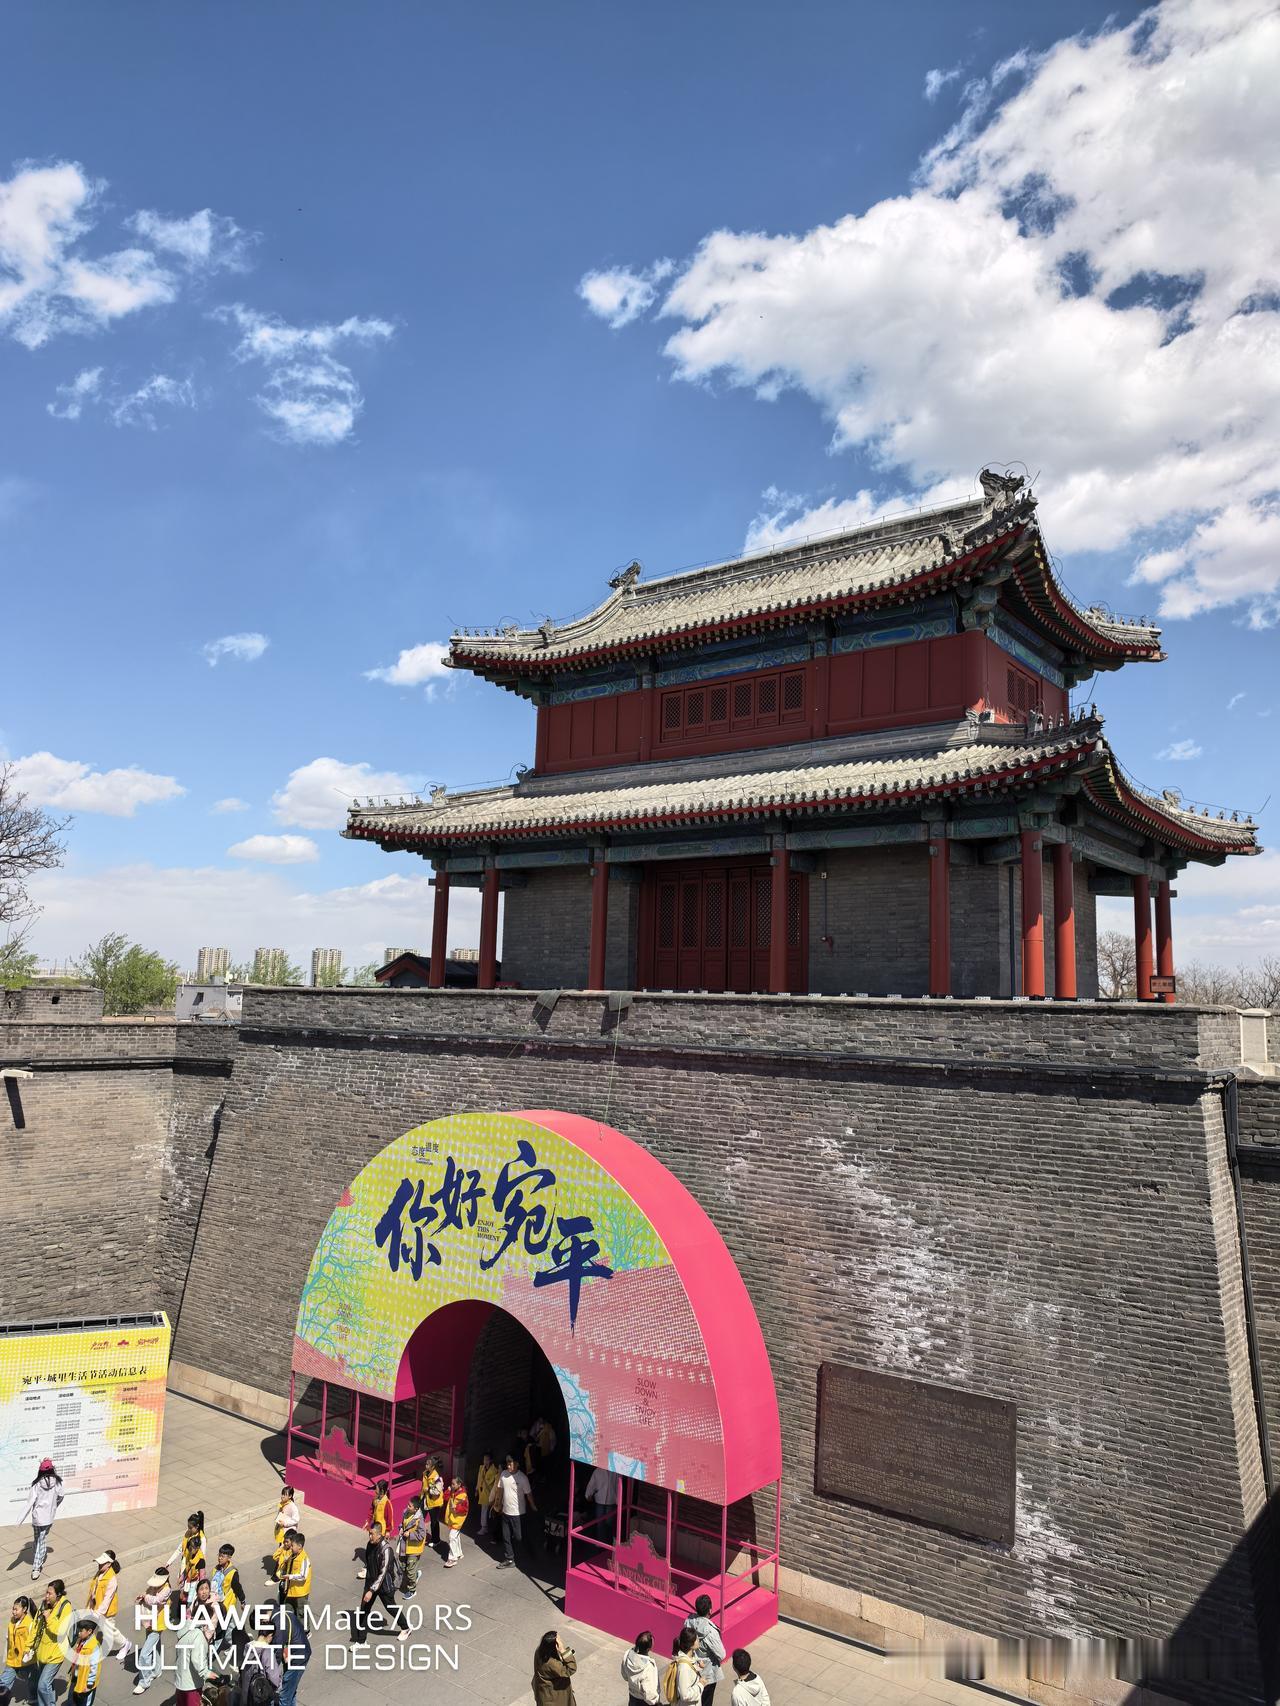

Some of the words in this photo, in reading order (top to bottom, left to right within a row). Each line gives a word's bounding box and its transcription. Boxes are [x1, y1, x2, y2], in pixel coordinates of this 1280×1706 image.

[477, 1219, 494, 1227] ENJOY
[375, 1140, 614, 1338] 你好宛平
[477, 1233, 500, 1241] MOMENT
[22, 1366, 147, 1385] 宛平·城里生活节活动信息表
[636, 1378, 657, 1389] SLOW
[635, 1387, 658, 1399] DOWN
[635, 1405, 656, 1417] ENJOY
